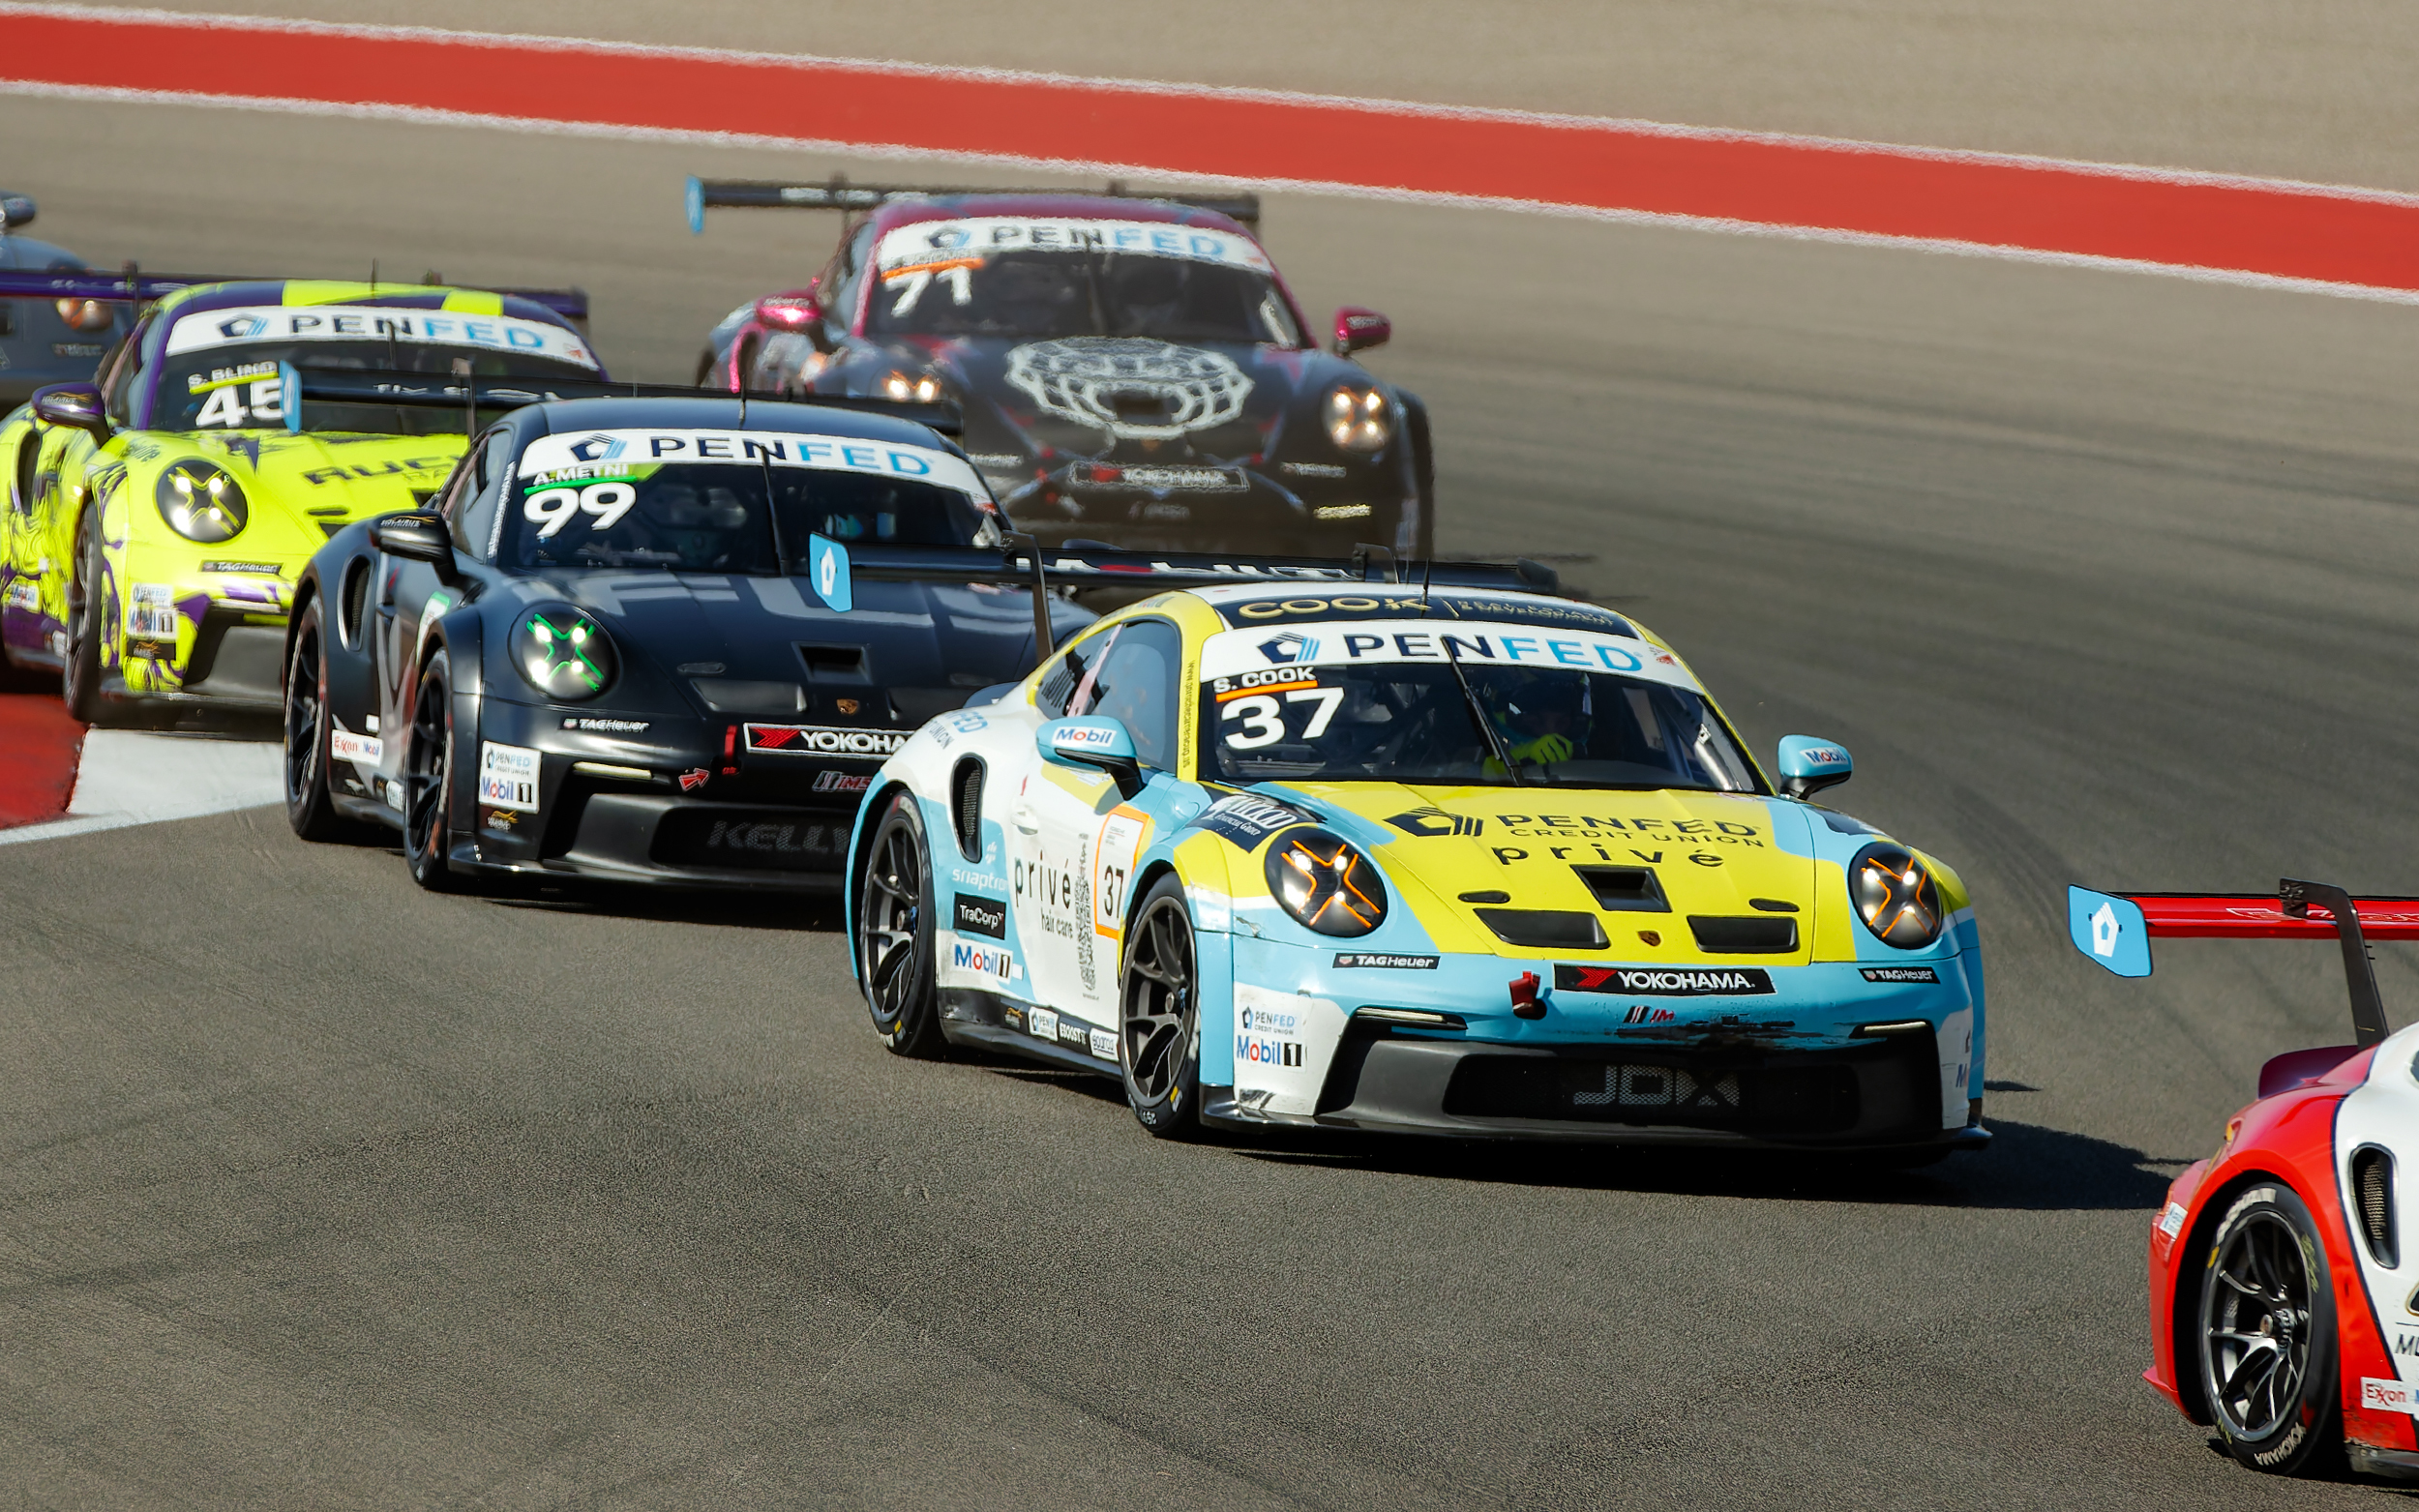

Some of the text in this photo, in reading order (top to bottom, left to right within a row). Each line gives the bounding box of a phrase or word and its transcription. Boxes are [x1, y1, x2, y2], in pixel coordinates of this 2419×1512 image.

[991, 225, 1226, 256] PENFED
[884, 265, 971, 318] 71
[291, 314, 544, 350] PENFED
[195, 378, 284, 429] 45
[650, 436, 931, 475] PENFED
[523, 482, 637, 539] 99
[1239, 597, 1432, 619] COOK
[1343, 633, 1643, 671] PENFED
[1213, 666, 1317, 694] S. COOK
[1221, 686, 1345, 750] 37
[1056, 727, 1113, 744] Mobil
[495, 751, 531, 768] PENFED
[1805, 748, 1847, 763] Mobil
[481, 776, 514, 801] Mobil
[1496, 814, 1758, 837] PENFED
[1510, 827, 1766, 847] CREDIT UNION
[1490, 843, 1725, 867] privé
[1014, 848, 1071, 909] privé
[1104, 864, 1124, 920] 37
[959, 904, 999, 930] TraCorp
[1040, 907, 1074, 939] hair care
[954, 944, 1009, 978] Mobil 1
[1617, 970, 1753, 991] YOKOHAMA
[1254, 1023, 1295, 1036] CREDIT UNION
[1255, 1010, 1296, 1028] PENFED
[1237, 1034, 1299, 1066] Mobil 1
[2365, 1382, 2407, 1408] Exxon
